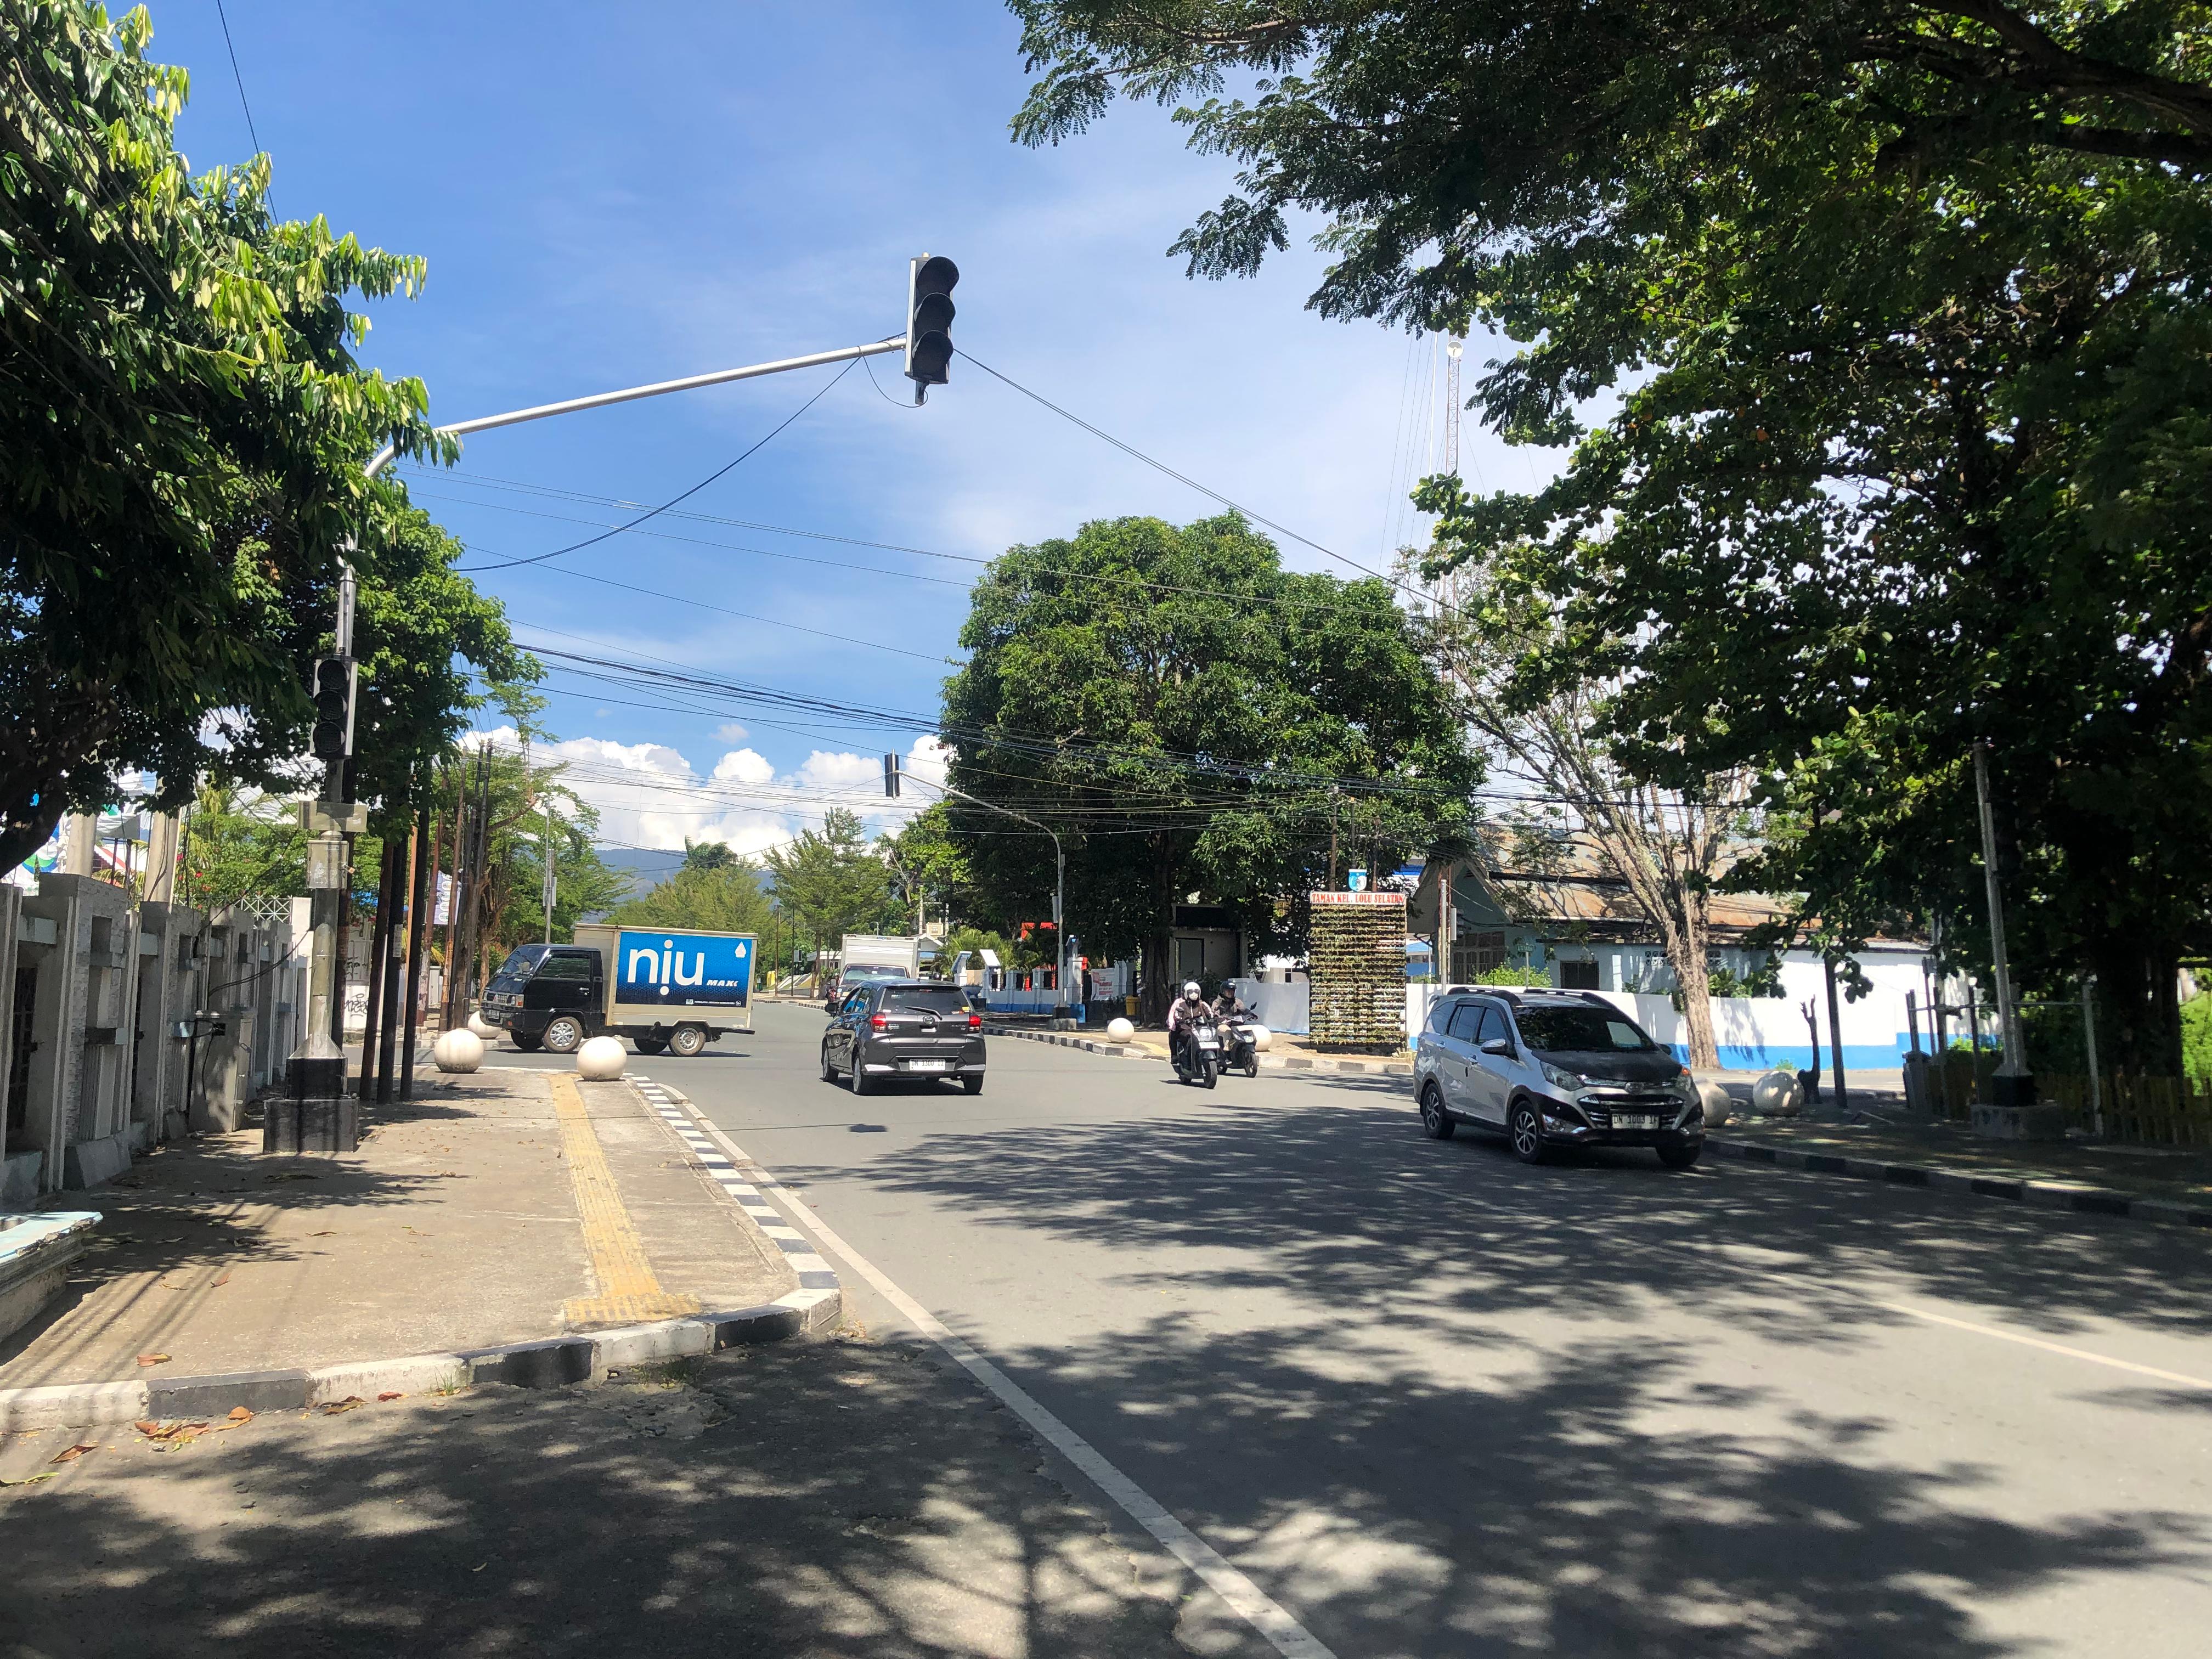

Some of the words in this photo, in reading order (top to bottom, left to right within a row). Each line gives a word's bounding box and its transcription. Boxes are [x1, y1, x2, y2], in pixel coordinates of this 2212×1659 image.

[1312, 894, 1335, 903] TAMAN
[1355, 894, 1372, 903] LOLU
[1374, 894, 1403, 903] SELATAN
[1613, 1114, 1623, 1124] DN
